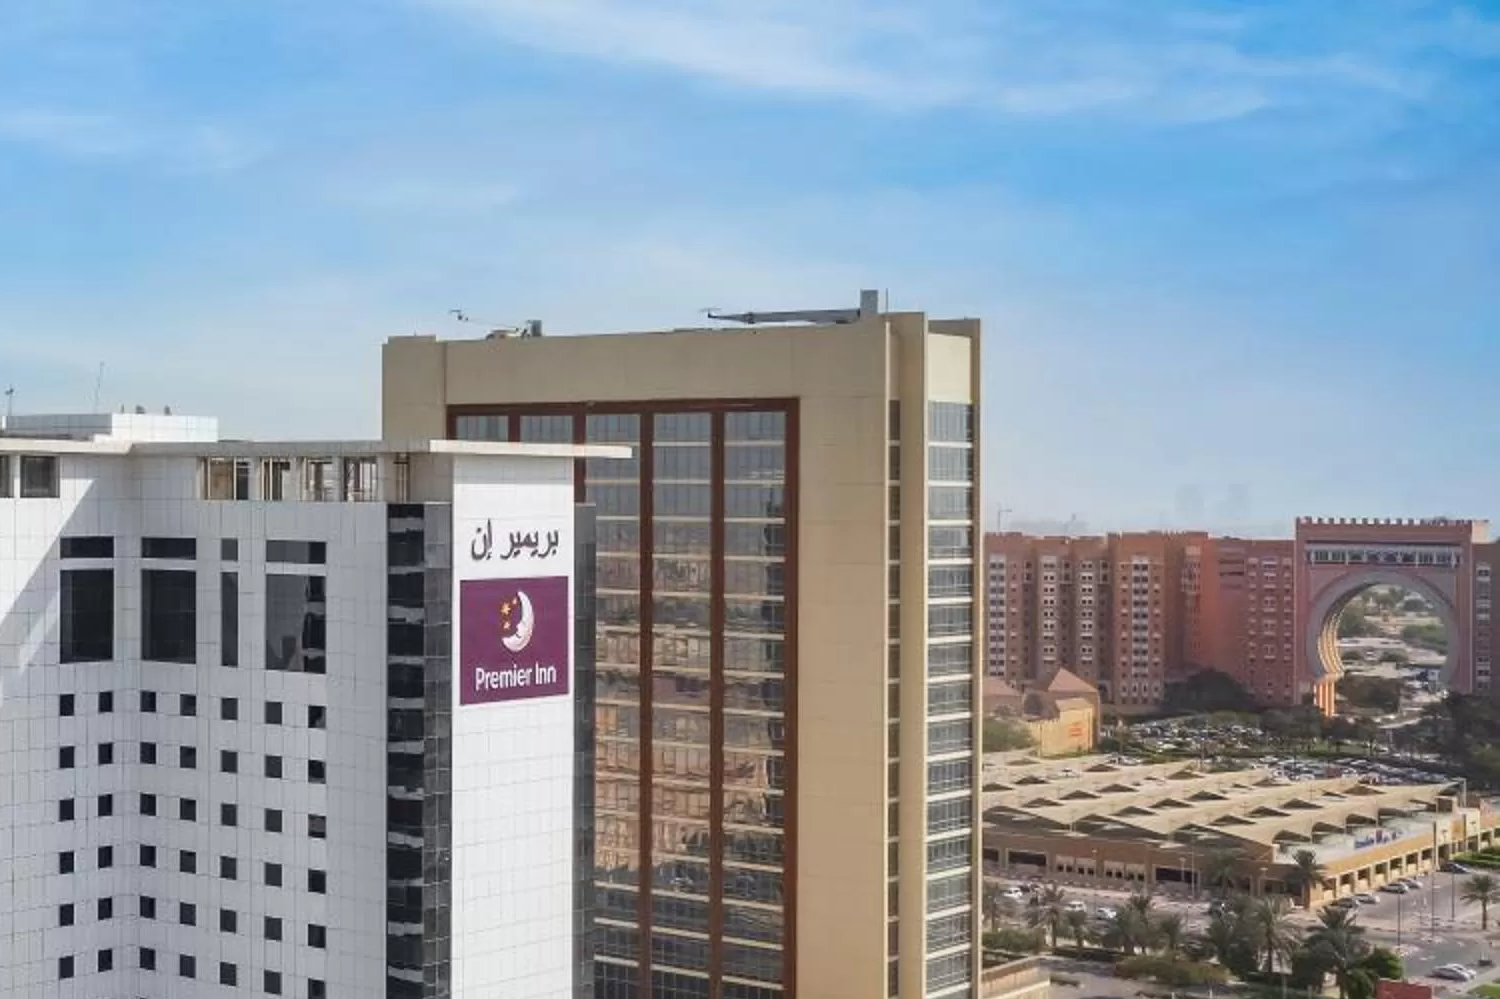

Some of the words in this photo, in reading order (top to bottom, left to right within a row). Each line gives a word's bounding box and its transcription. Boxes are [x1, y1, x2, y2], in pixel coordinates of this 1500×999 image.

[471, 518, 493, 561] إن
[500, 528, 559, 560] بريمير
[475, 663, 532, 691] Premier
[535, 662, 557, 684] Inn
